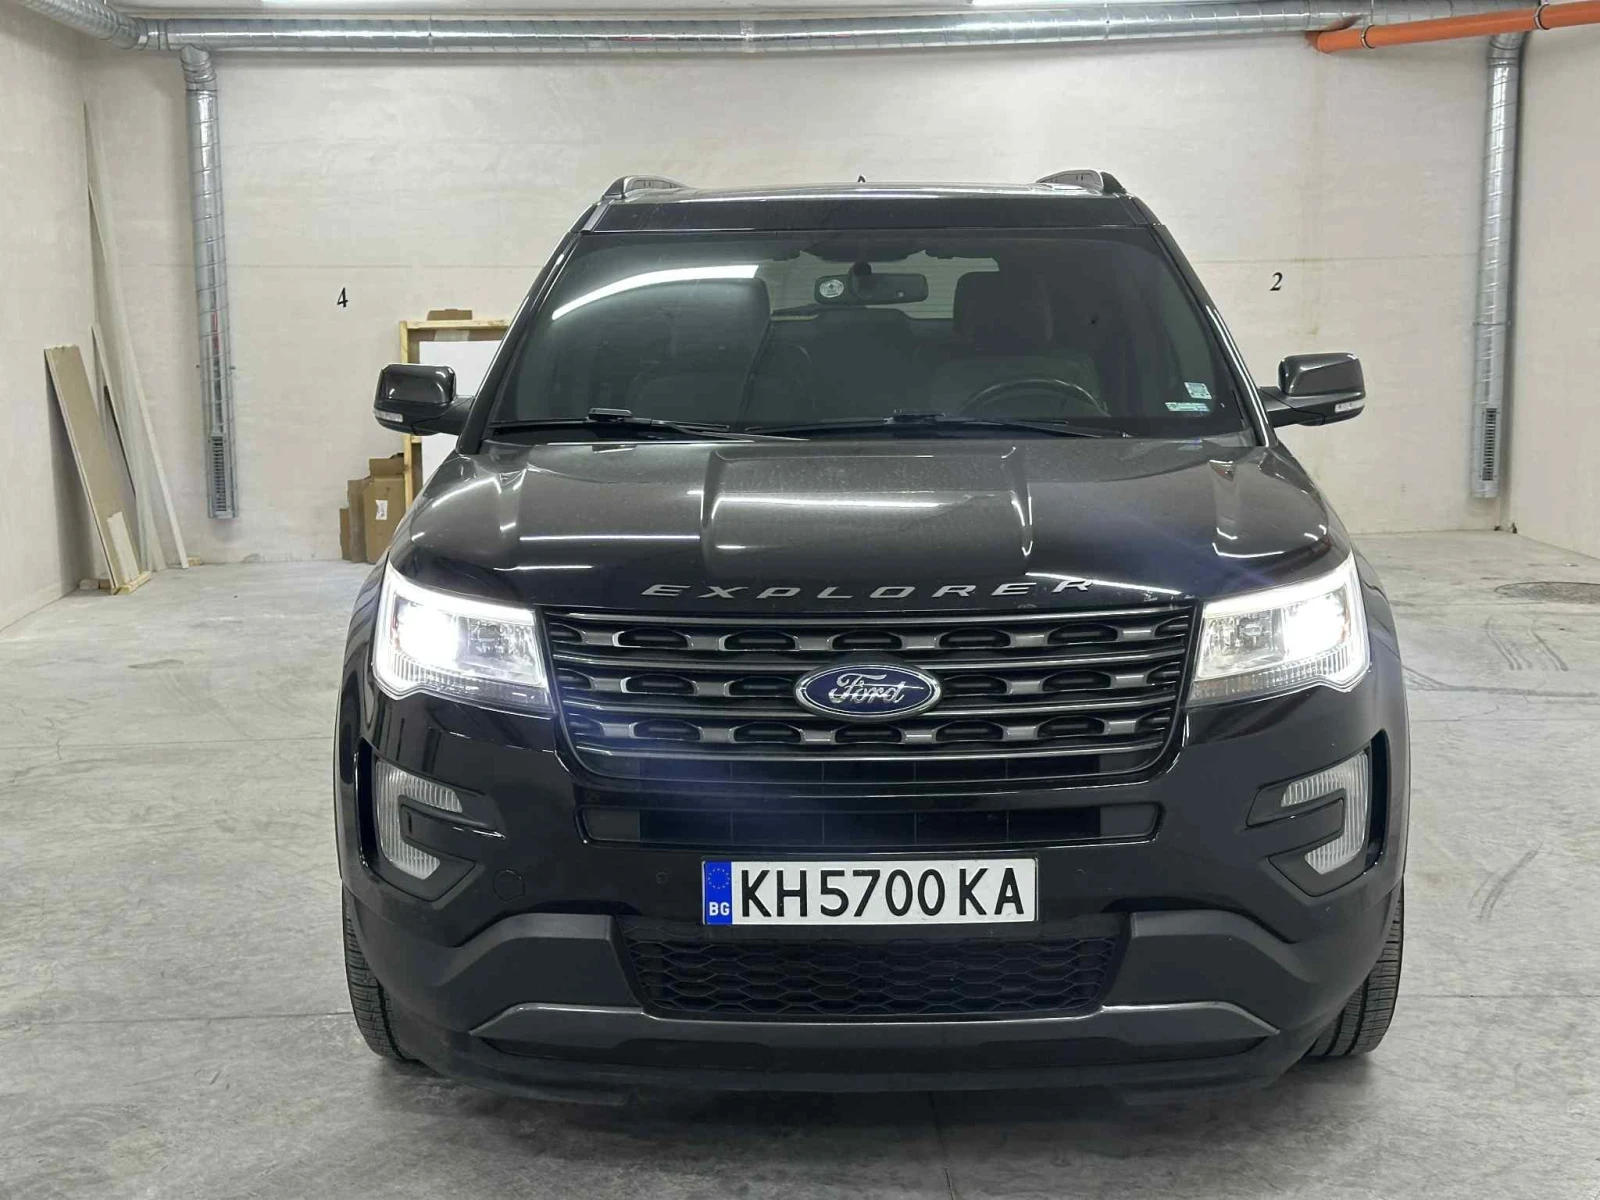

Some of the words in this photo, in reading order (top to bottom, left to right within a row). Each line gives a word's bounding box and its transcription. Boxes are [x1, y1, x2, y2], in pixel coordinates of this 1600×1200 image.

[1270, 271, 1283, 291] 2
[337, 287, 348, 307] 4
[641, 579, 1095, 599] EXPLORER
[828, 672, 923, 705] Ford
[709, 902, 730, 917] BG
